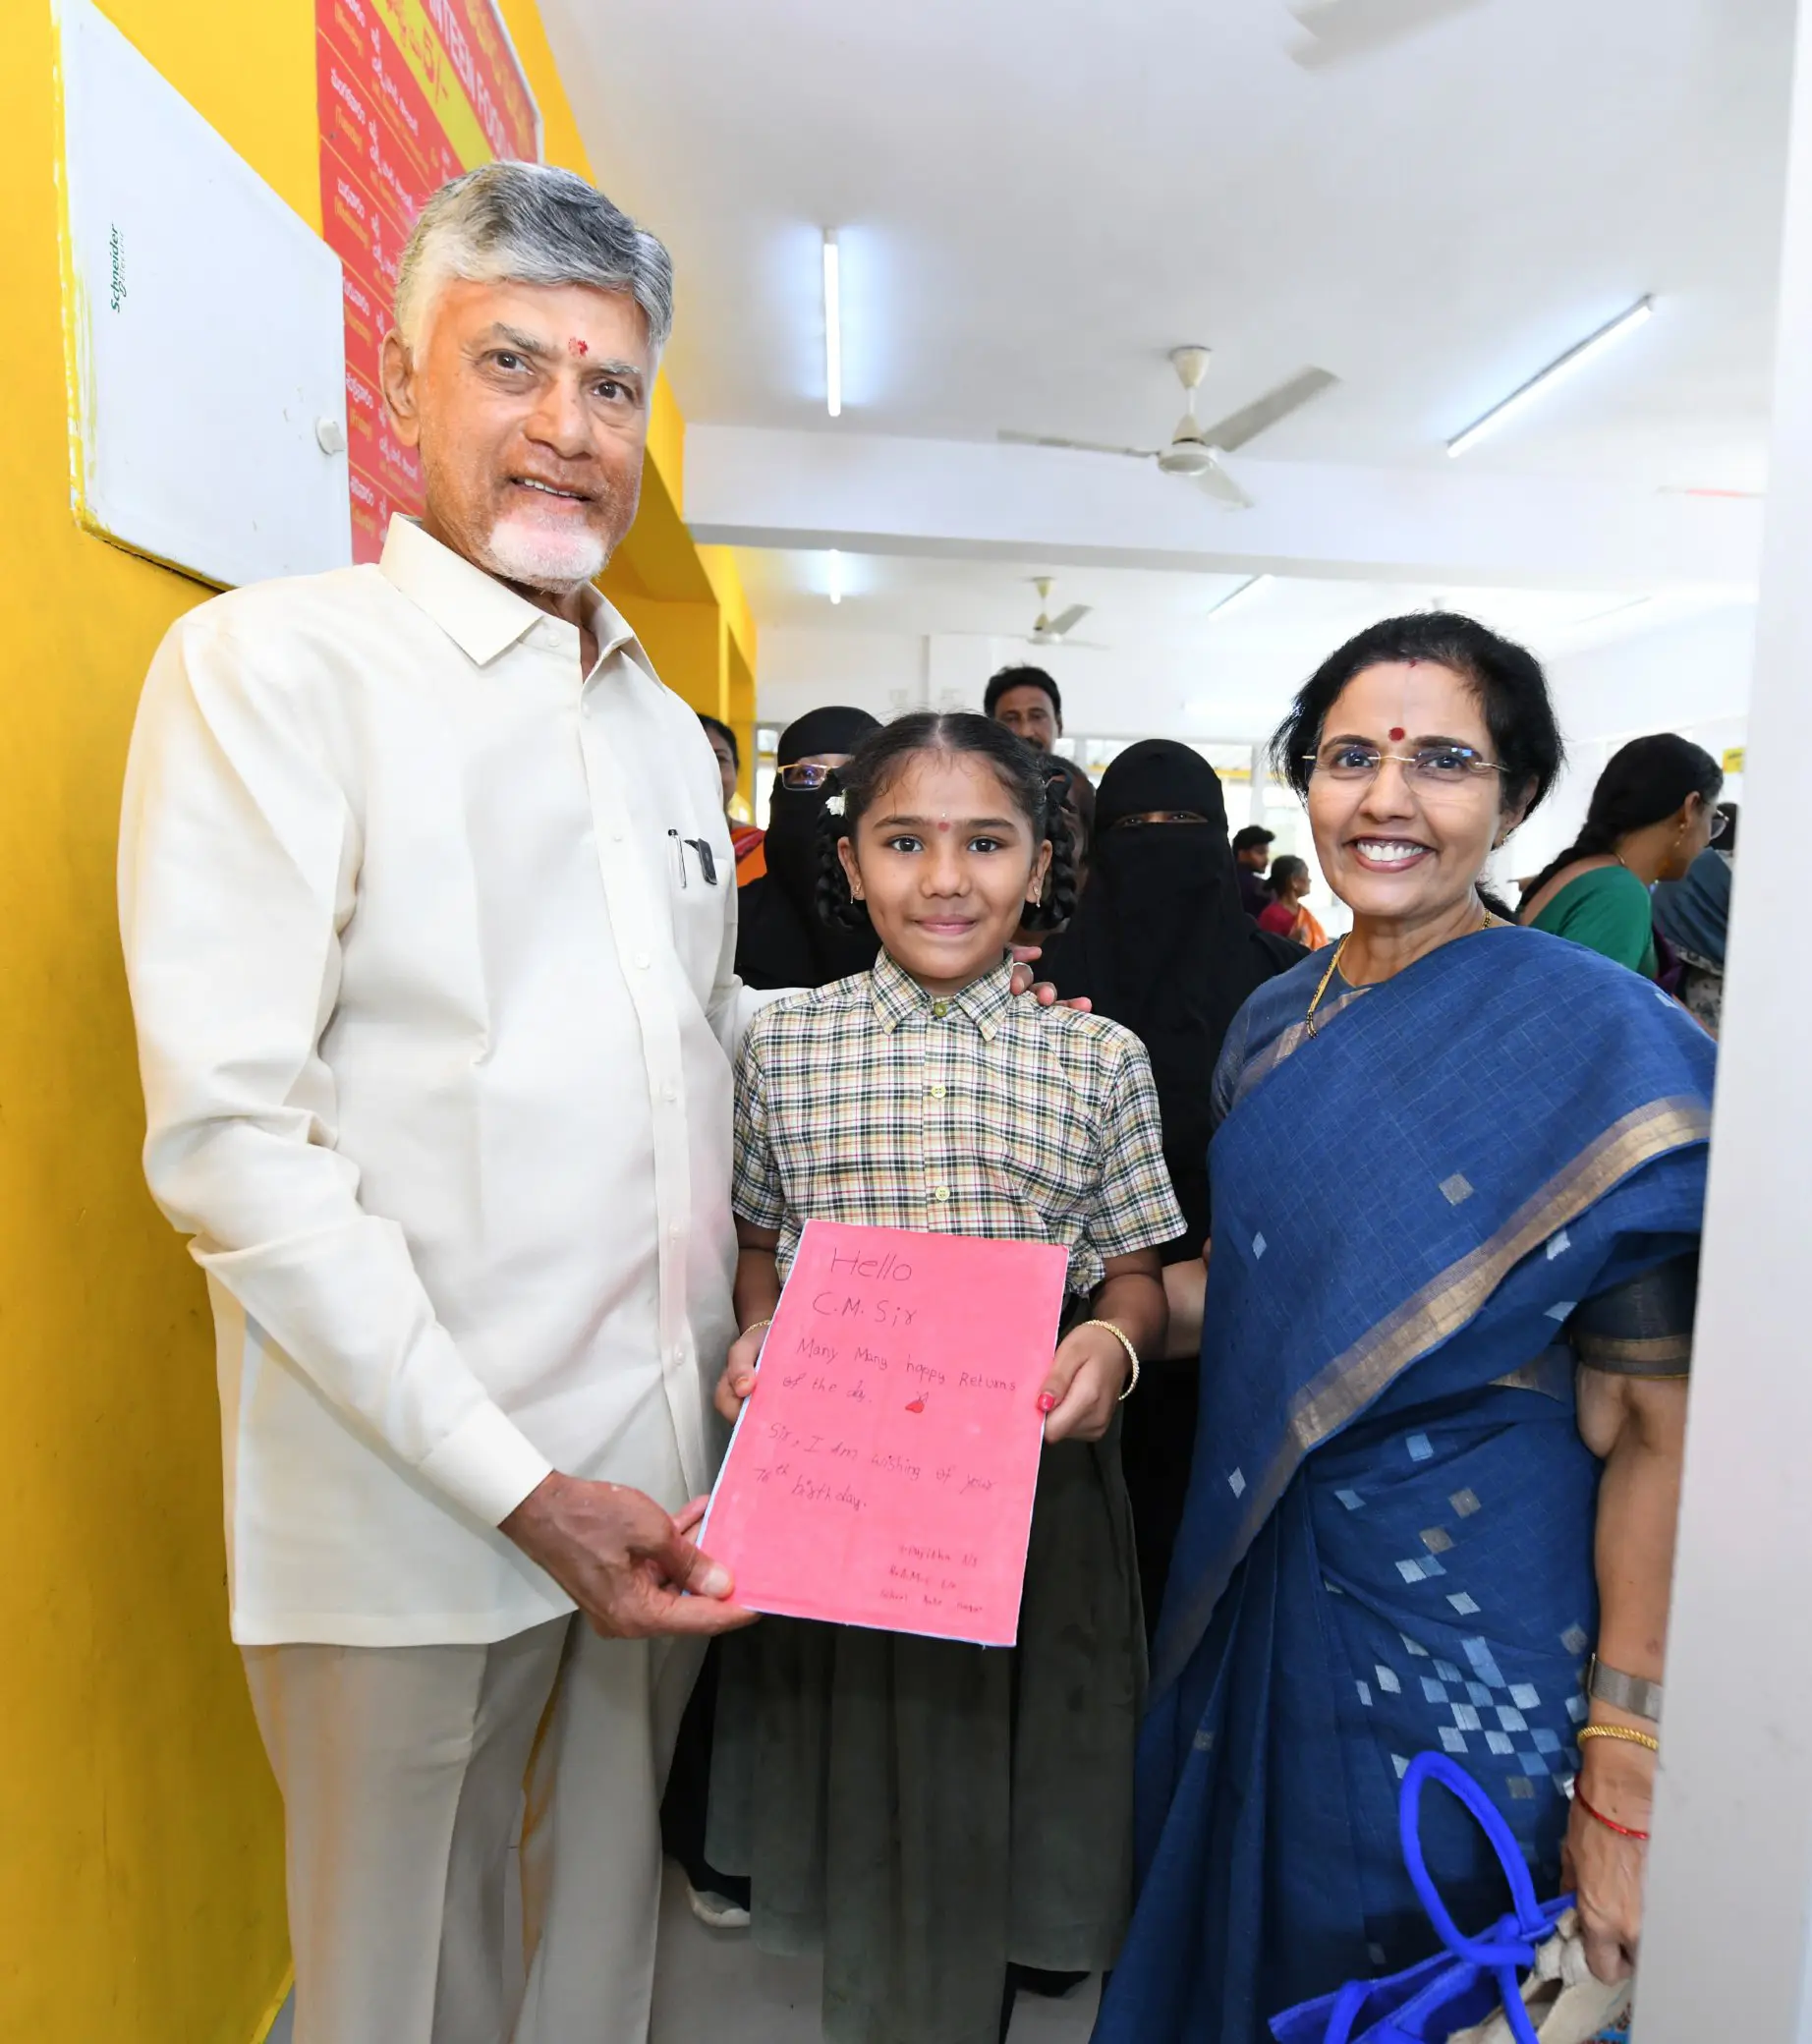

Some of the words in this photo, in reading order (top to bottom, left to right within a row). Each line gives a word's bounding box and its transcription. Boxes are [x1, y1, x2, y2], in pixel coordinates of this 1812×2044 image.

[110, 220, 120, 313] Schneider
[830, 1247, 913, 1281] Hello
[875, 1299, 918, 1328] Sir
[782, 1372, 807, 1390] of
[812, 1377, 837, 1391] the
[796, 1337, 838, 1365] Many
[854, 1346, 888, 1371] Many
[906, 1353, 945, 1385] happy
[959, 1371, 1016, 1391] Returns
[804, 1435, 824, 1453] I
[935, 1464, 957, 1485] of
